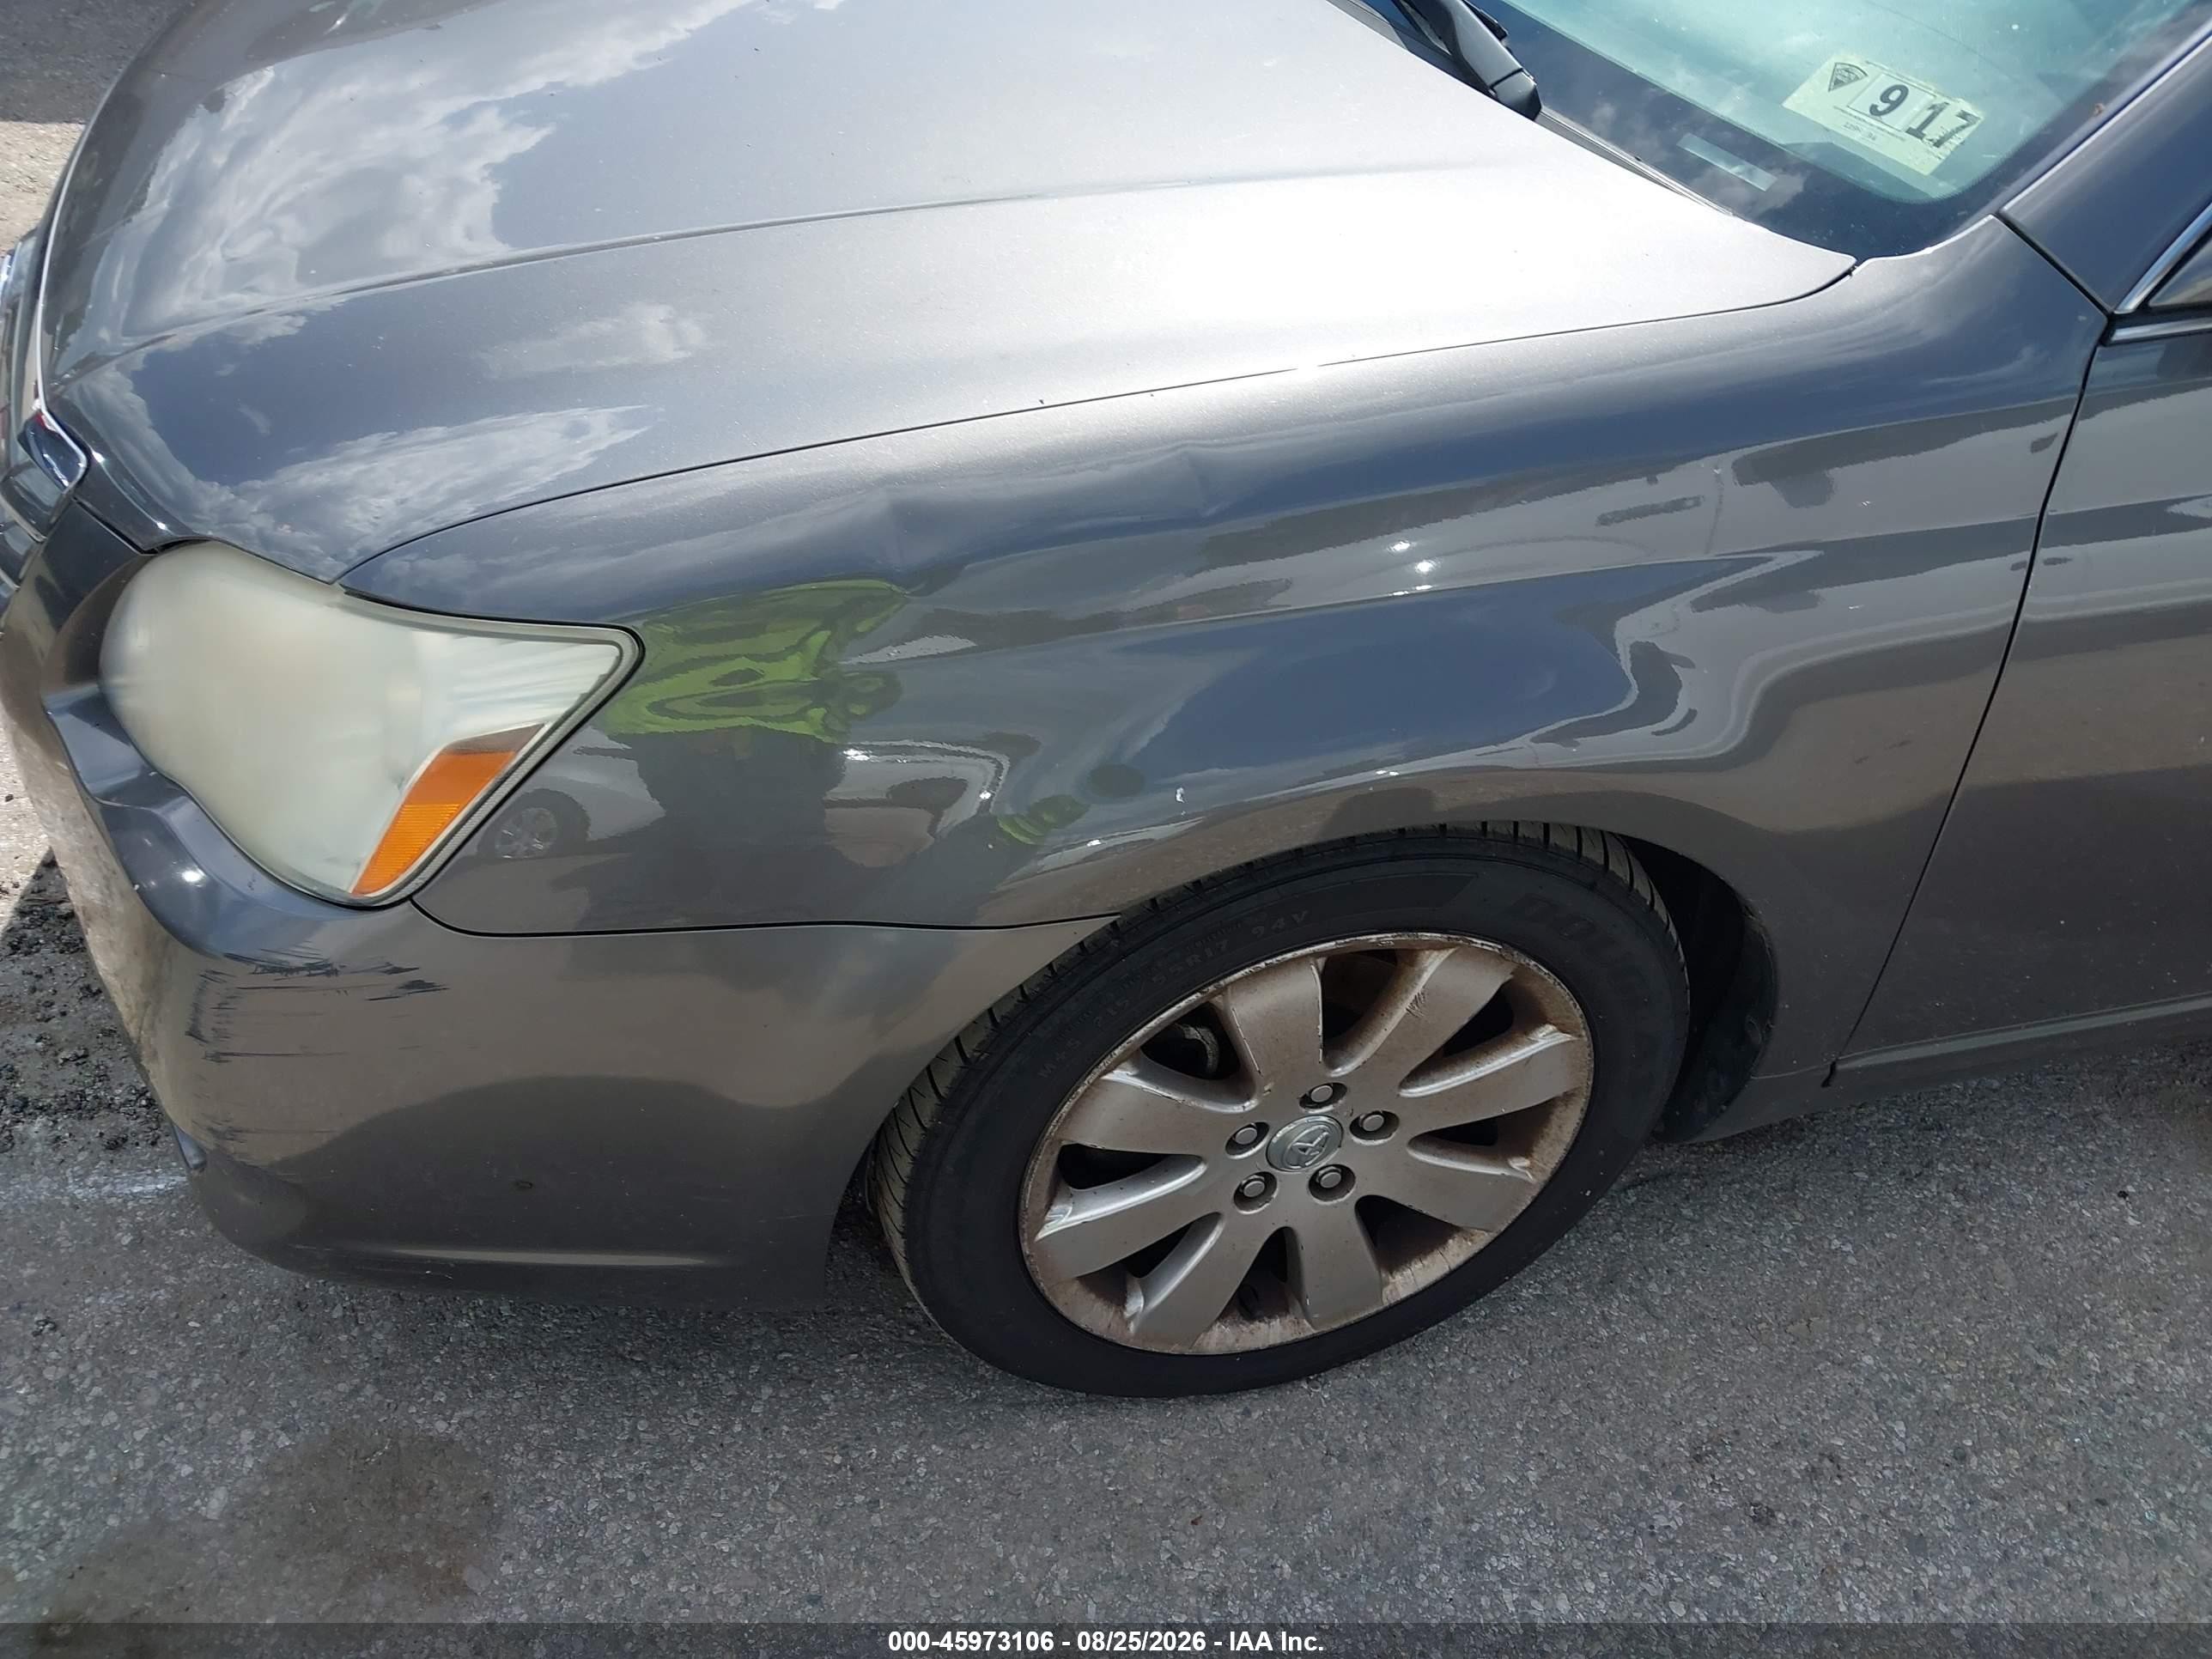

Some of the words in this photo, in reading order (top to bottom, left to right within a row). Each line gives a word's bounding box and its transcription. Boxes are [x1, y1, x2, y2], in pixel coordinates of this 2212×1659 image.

[1869, 83, 1910, 117] 9
[1905, 101, 1980, 149] 17
[1250, 908, 1310, 939] 94V
